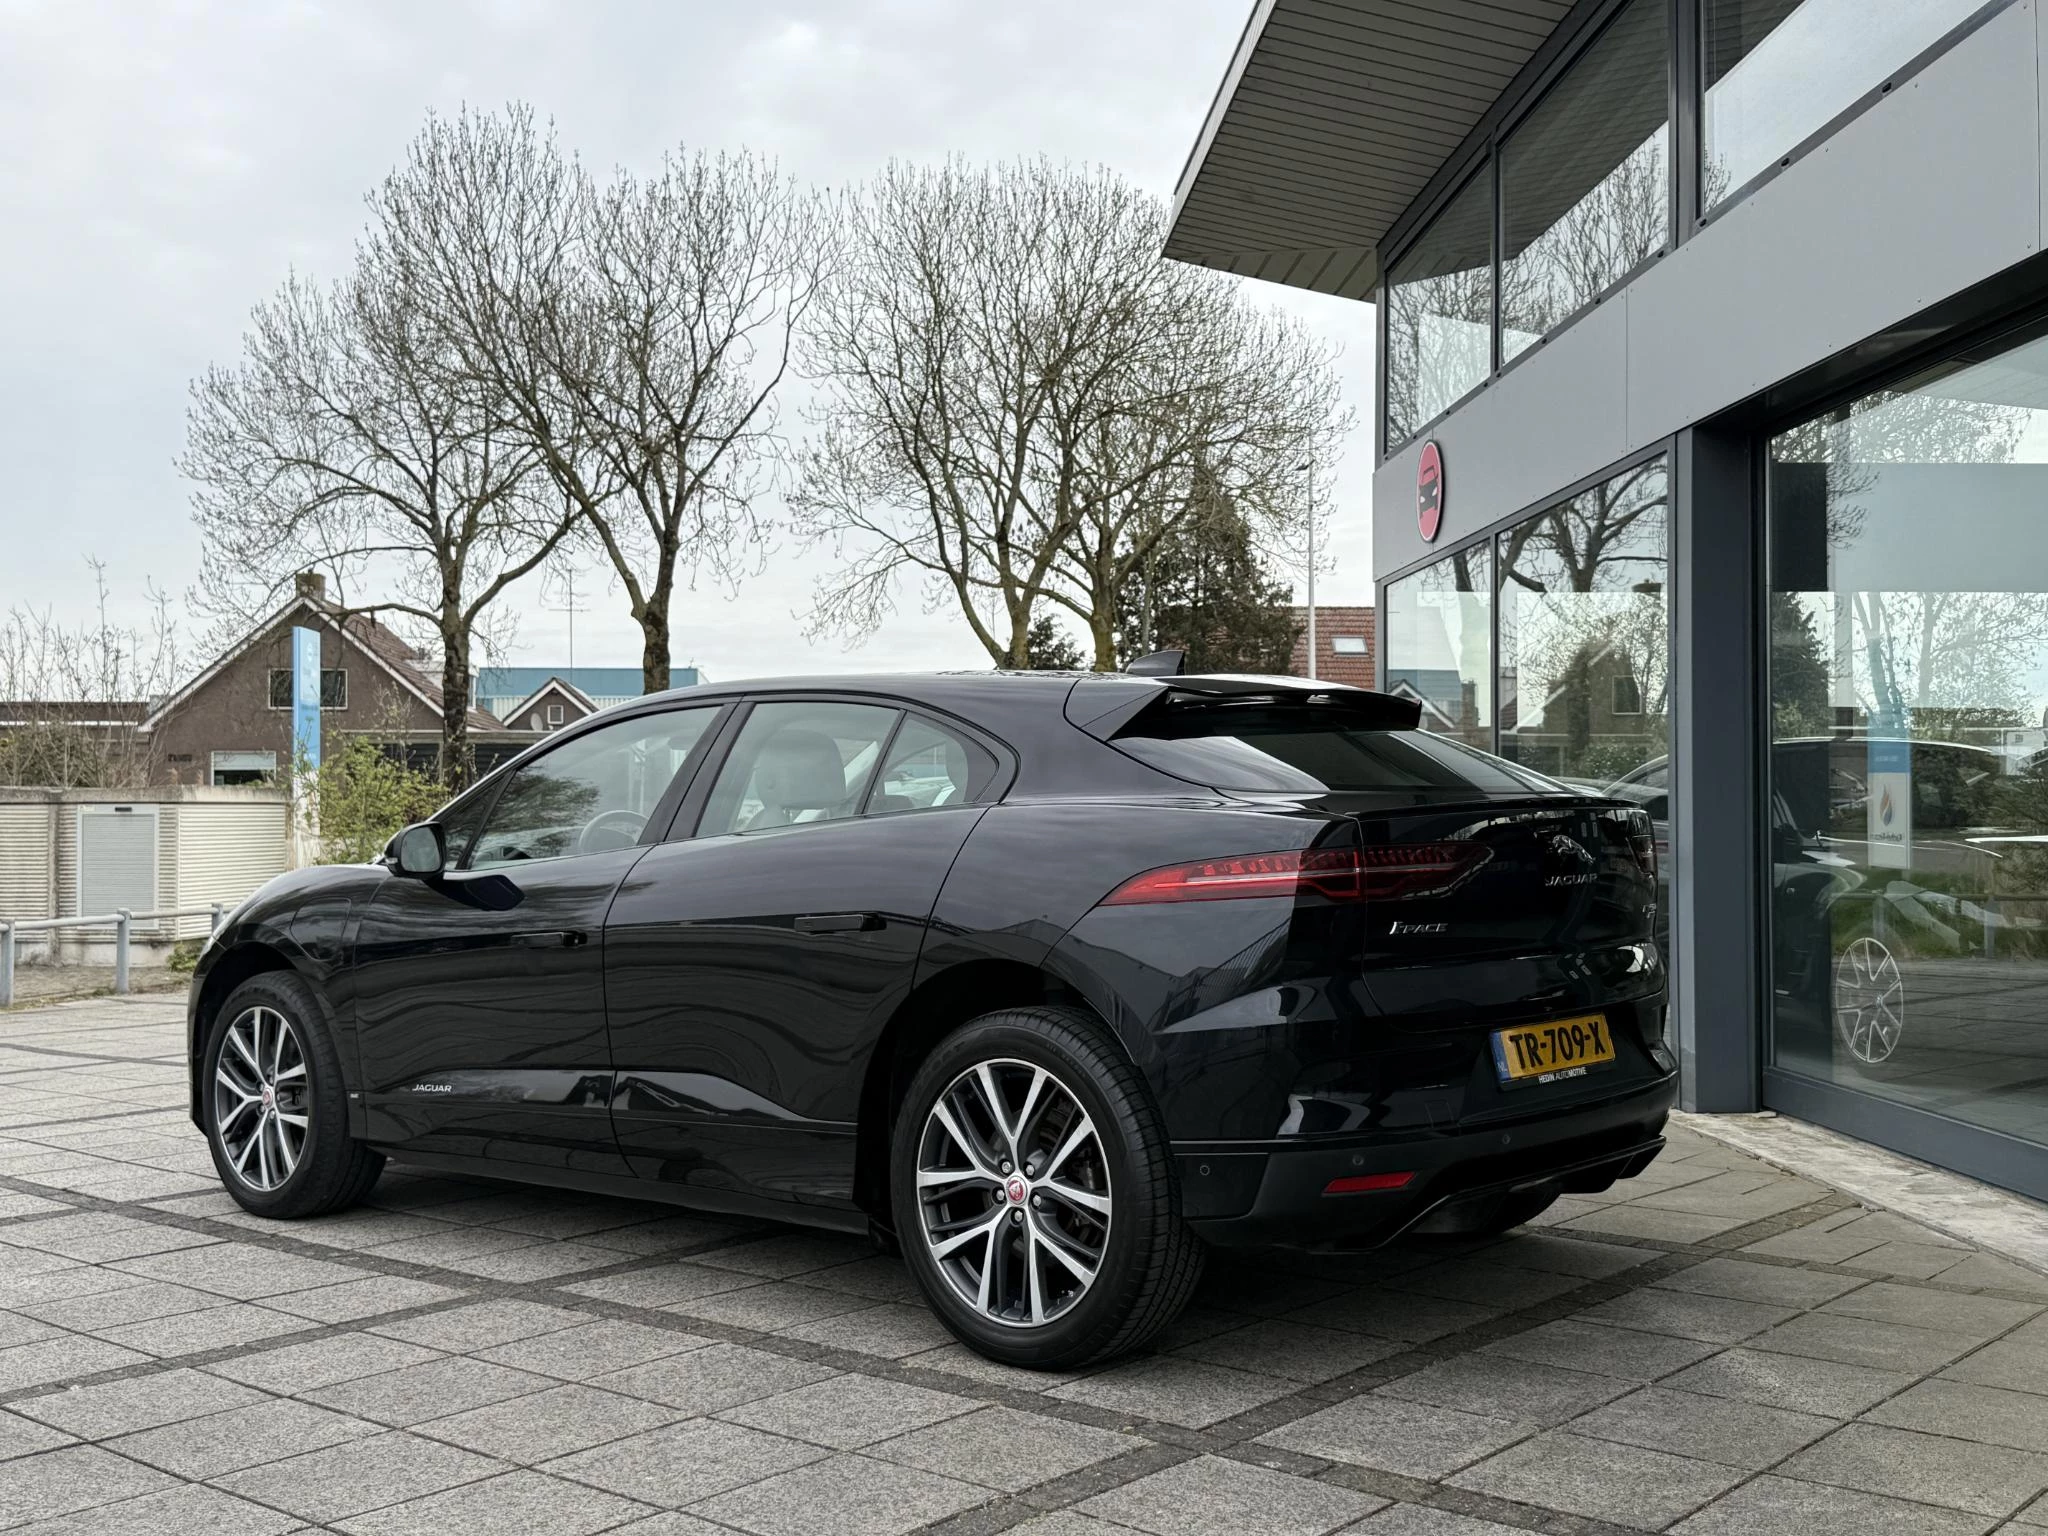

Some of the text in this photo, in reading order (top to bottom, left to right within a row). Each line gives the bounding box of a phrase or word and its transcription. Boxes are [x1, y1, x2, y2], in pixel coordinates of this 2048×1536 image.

[1545, 873, 1598, 886] JAGUAR
[1509, 1021, 1606, 1070] TR-709-X
[1555, 1066, 1588, 1081] AUTOMOTIVE
[412, 1084, 452, 1092] JAGUAR
